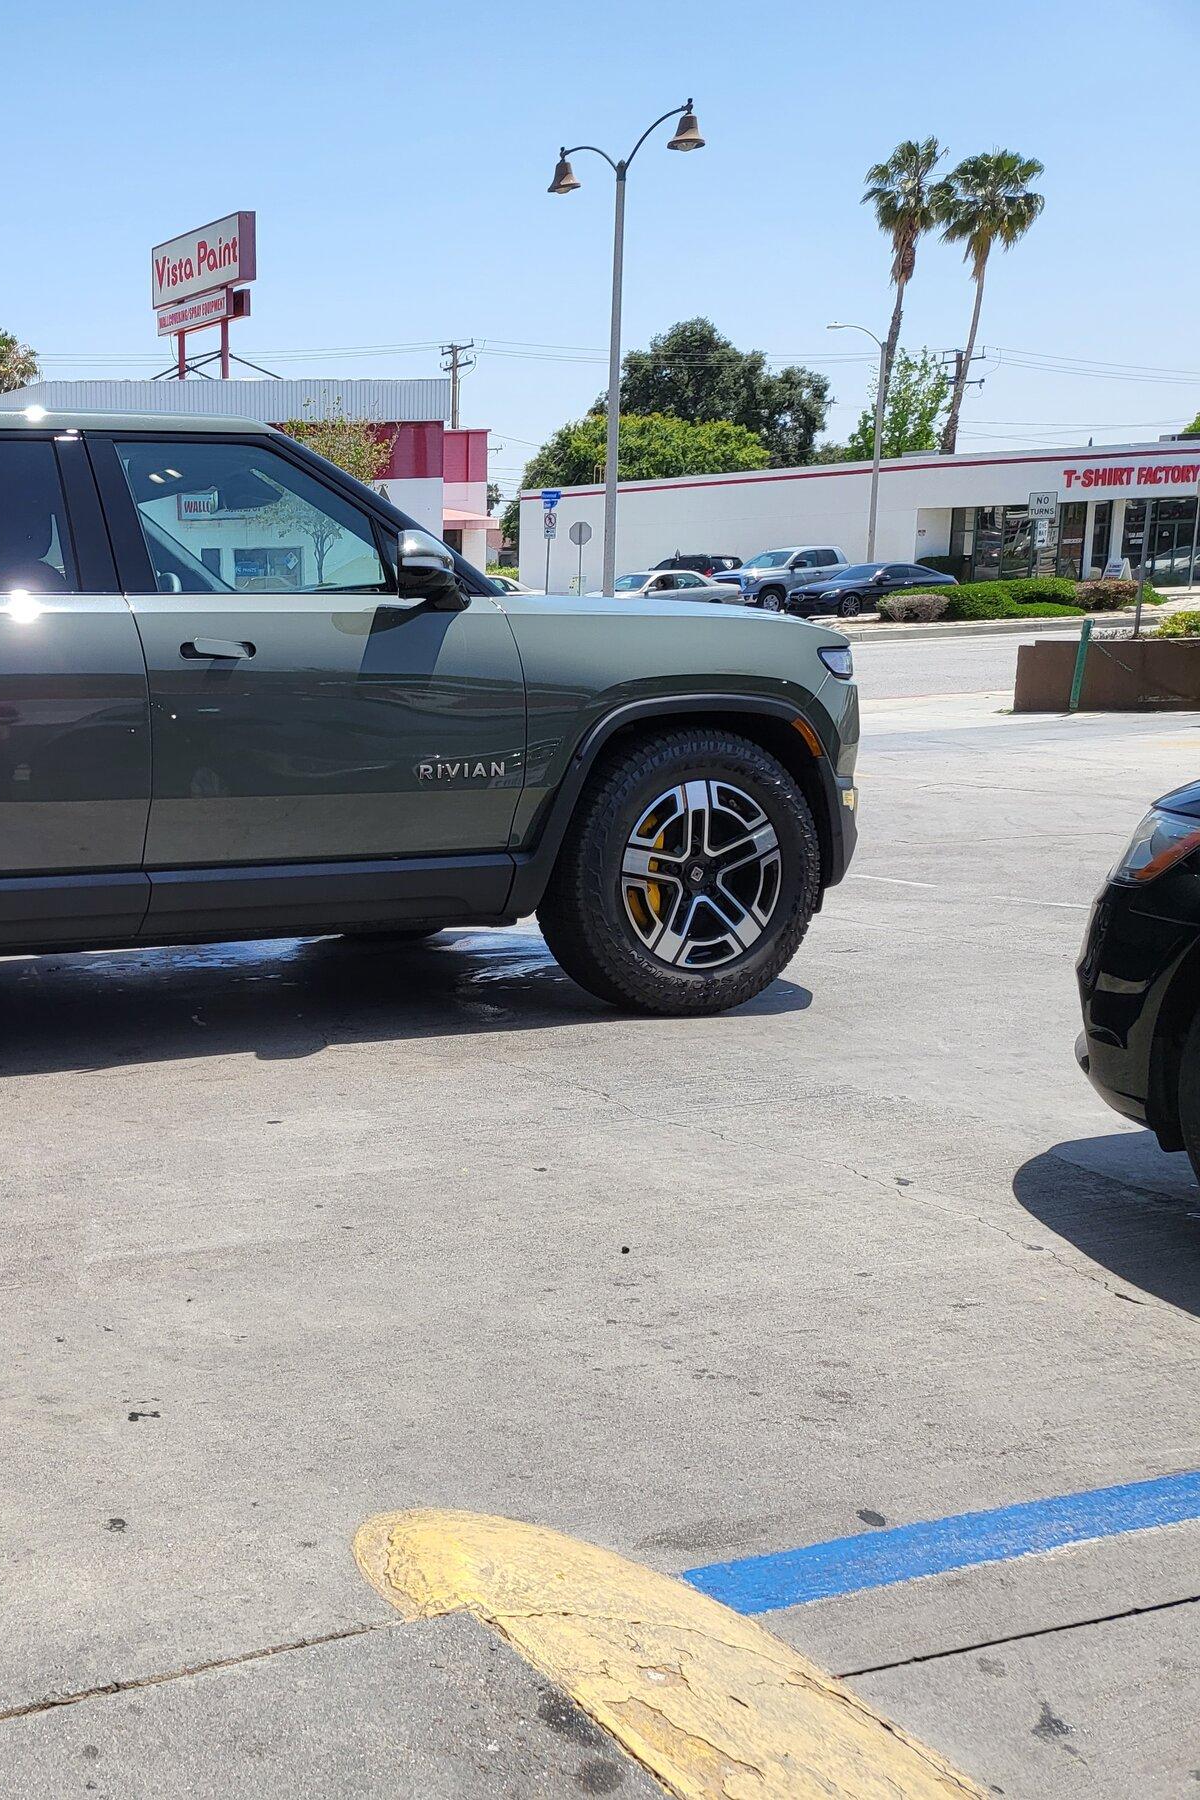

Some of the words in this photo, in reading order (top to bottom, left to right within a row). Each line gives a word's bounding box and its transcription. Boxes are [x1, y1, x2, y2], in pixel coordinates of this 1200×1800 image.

[155, 256, 194, 293] Vista
[197, 236, 238, 276] Paint
[1063, 467, 1135, 488] T-SHIRT
[1137, 464, 1200, 485] FACTORY
[1036, 496, 1050, 505] NO
[1030, 507, 1055, 516] TURNS
[419, 761, 505, 780] RIVIAN
